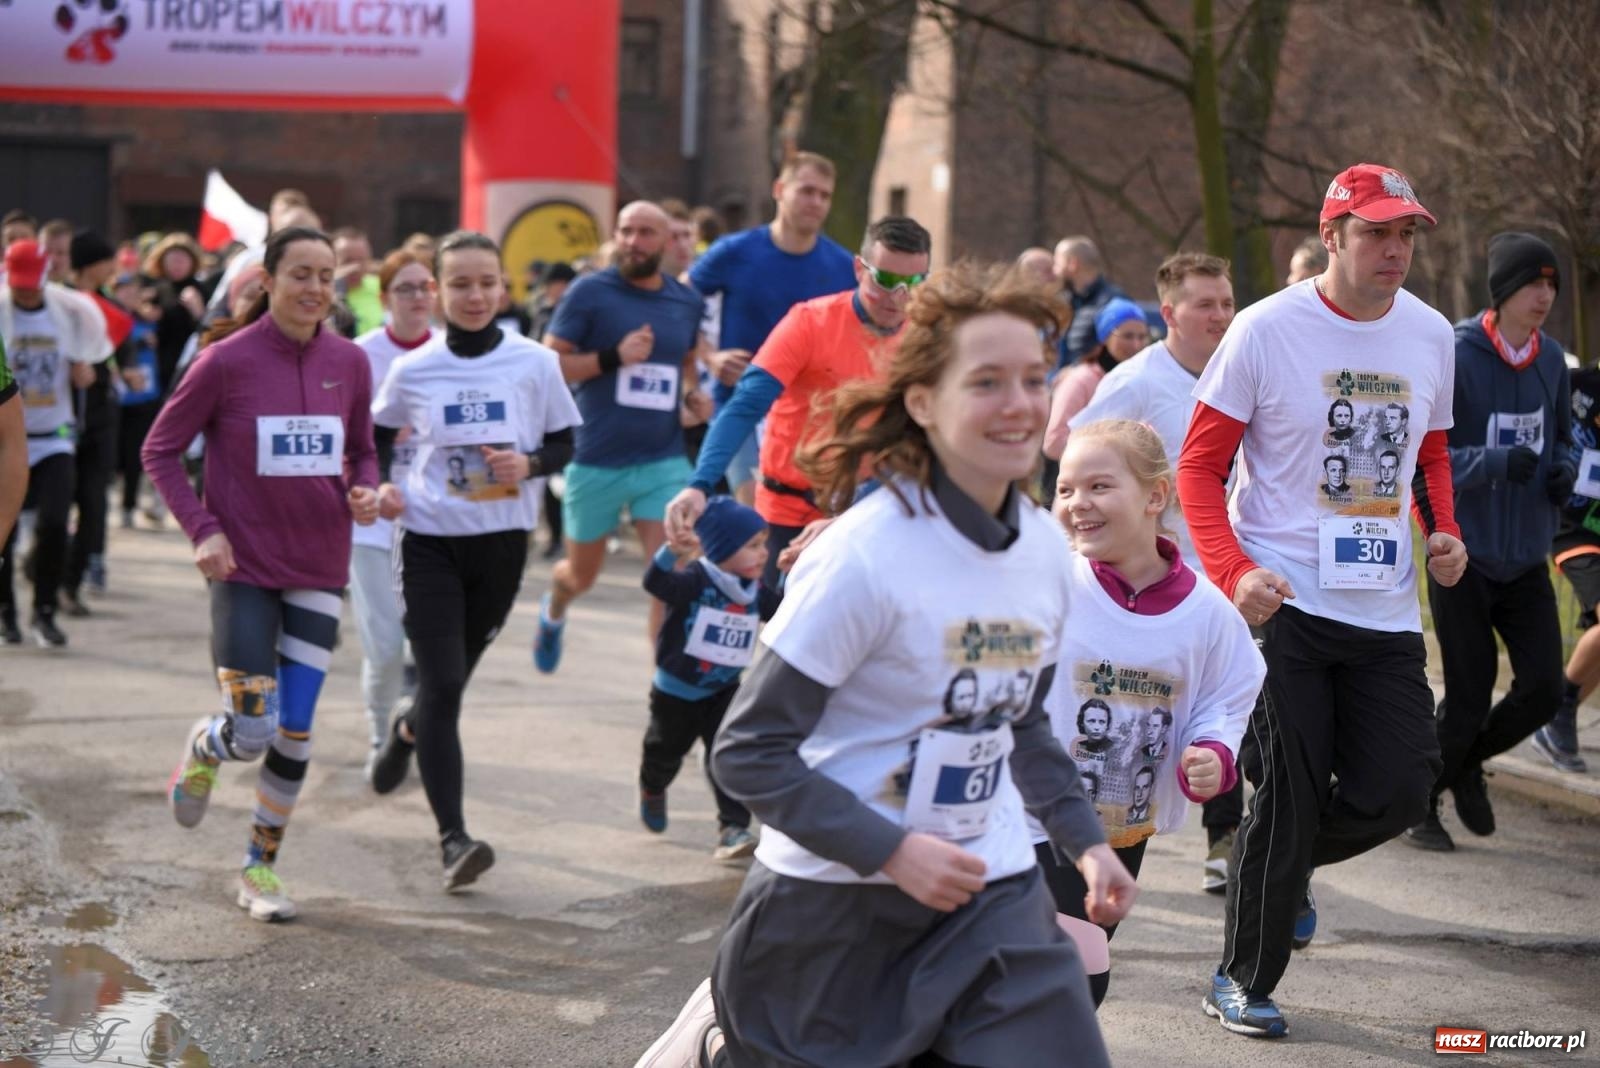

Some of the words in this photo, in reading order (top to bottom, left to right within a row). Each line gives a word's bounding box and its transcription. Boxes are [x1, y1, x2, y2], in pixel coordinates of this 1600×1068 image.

[1357, 381, 1401, 394] WILCZYM
[461, 403, 488, 423] 98
[286, 435, 324, 454] 115
[1514, 427, 1536, 446] 53
[1357, 539, 1385, 562] 30
[717, 628, 746, 649] 101
[1119, 668, 1149, 680] TROPEM
[1118, 678, 1172, 698] WILCZYM
[964, 765, 996, 801] 61
